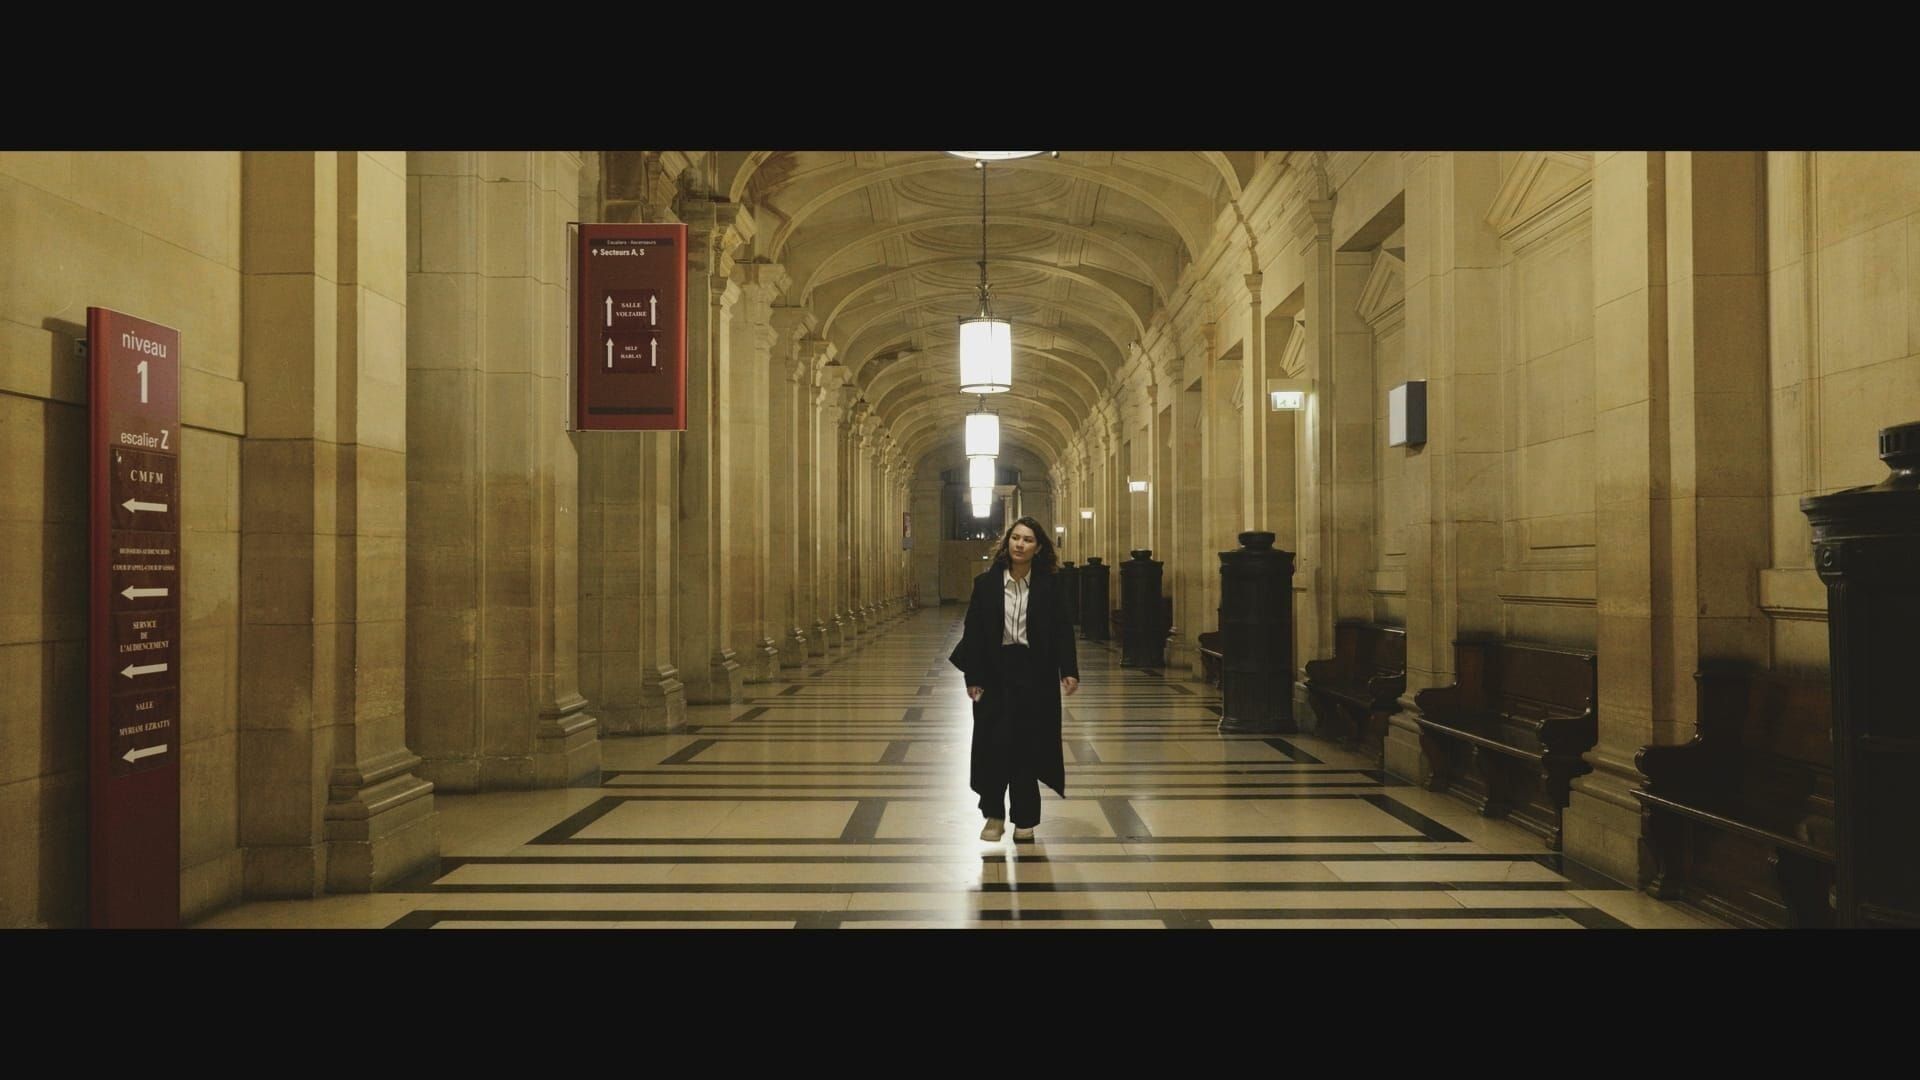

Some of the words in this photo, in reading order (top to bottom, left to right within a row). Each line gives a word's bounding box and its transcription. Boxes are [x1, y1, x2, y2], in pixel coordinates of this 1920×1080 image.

[600, 248, 630, 256] Secteurs
[639, 248, 645, 256] S
[122, 330, 167, 358] niveau
[137, 360, 149, 404] 1
[120, 432, 159, 448] escalier
[160, 429, 169, 450] Z
[132, 620, 157, 630] SERVICE
[140, 632, 148, 640] DE
[119, 640, 169, 653] L'AUDIENCEMENT
[135, 701, 154, 711] SALLE
[119, 724, 144, 737] MYRIAM
